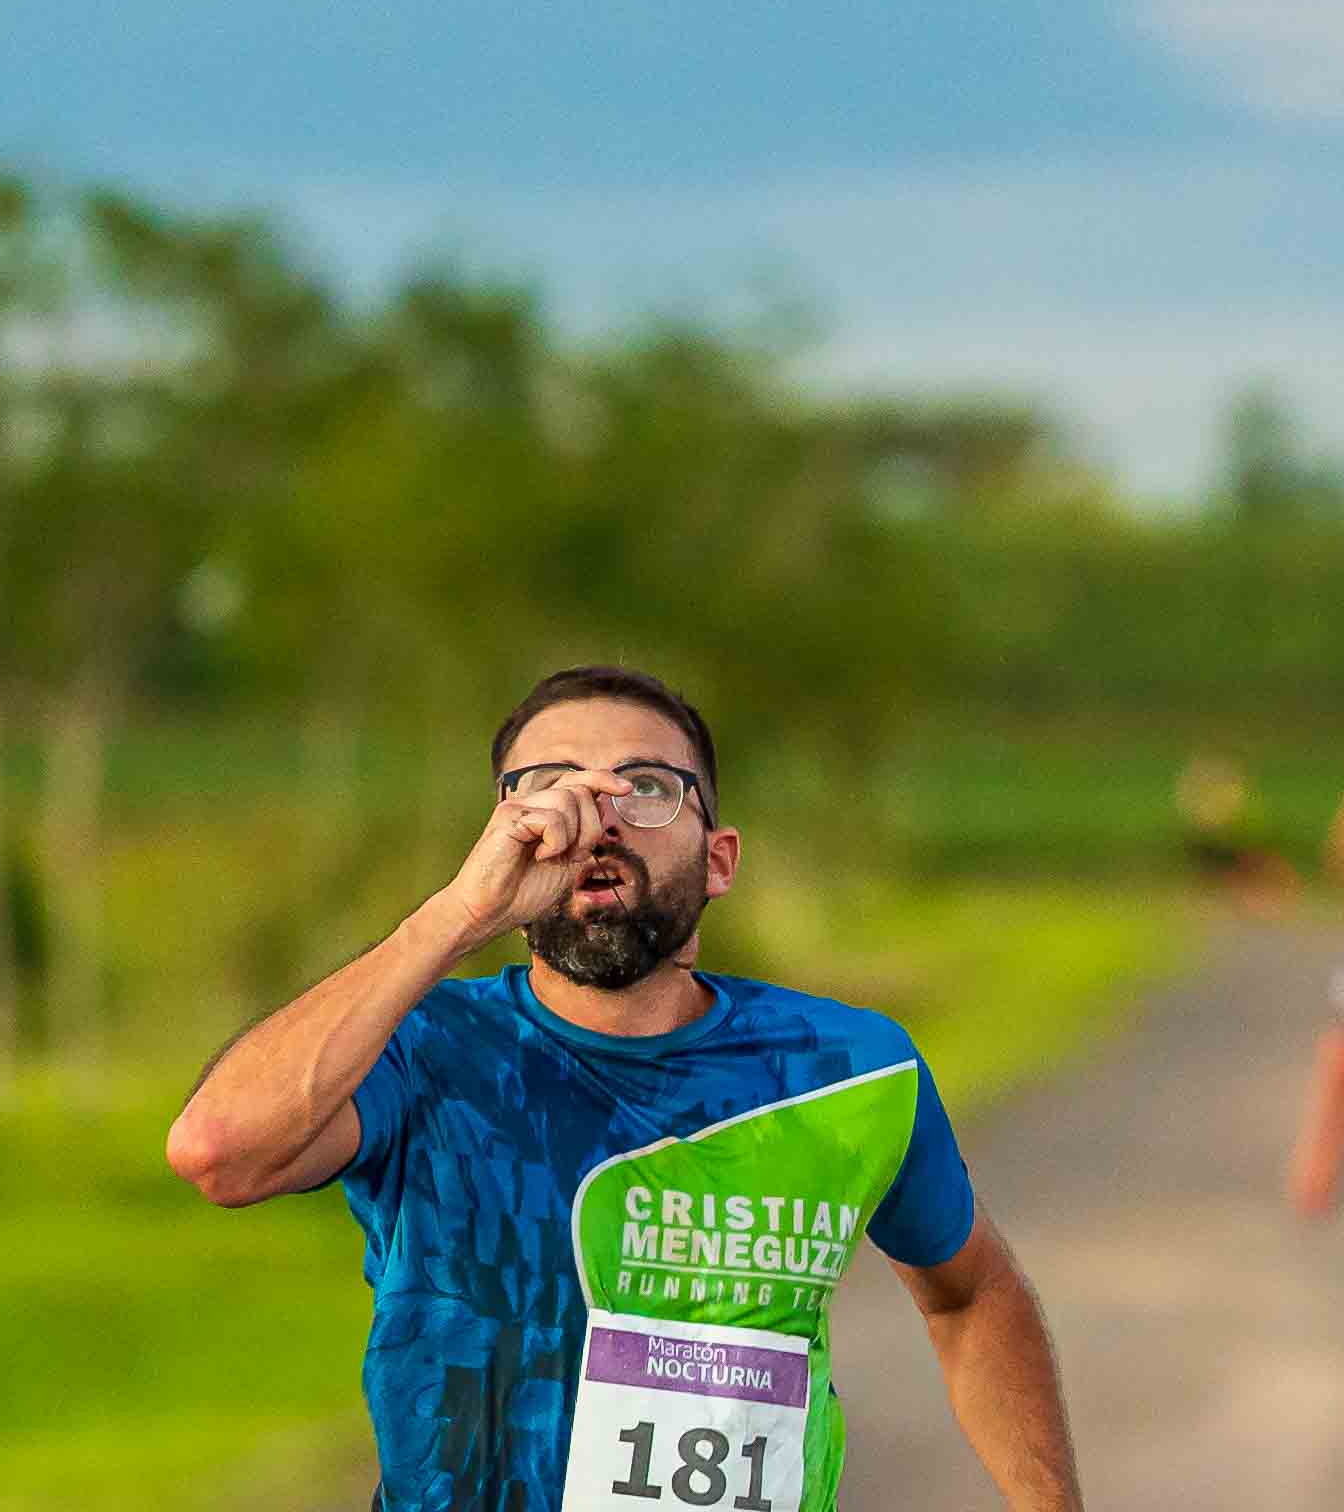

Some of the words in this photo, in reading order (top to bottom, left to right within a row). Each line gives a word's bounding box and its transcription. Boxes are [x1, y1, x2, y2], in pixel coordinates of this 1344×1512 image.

[625, 1186, 860, 1241] CRISTIAN
[616, 1271, 773, 1305] RUNNING
[648, 1335, 727, 1363] Maratón
[646, 1356, 773, 1390] NOCTURNA
[612, 1421, 772, 1512] 181
